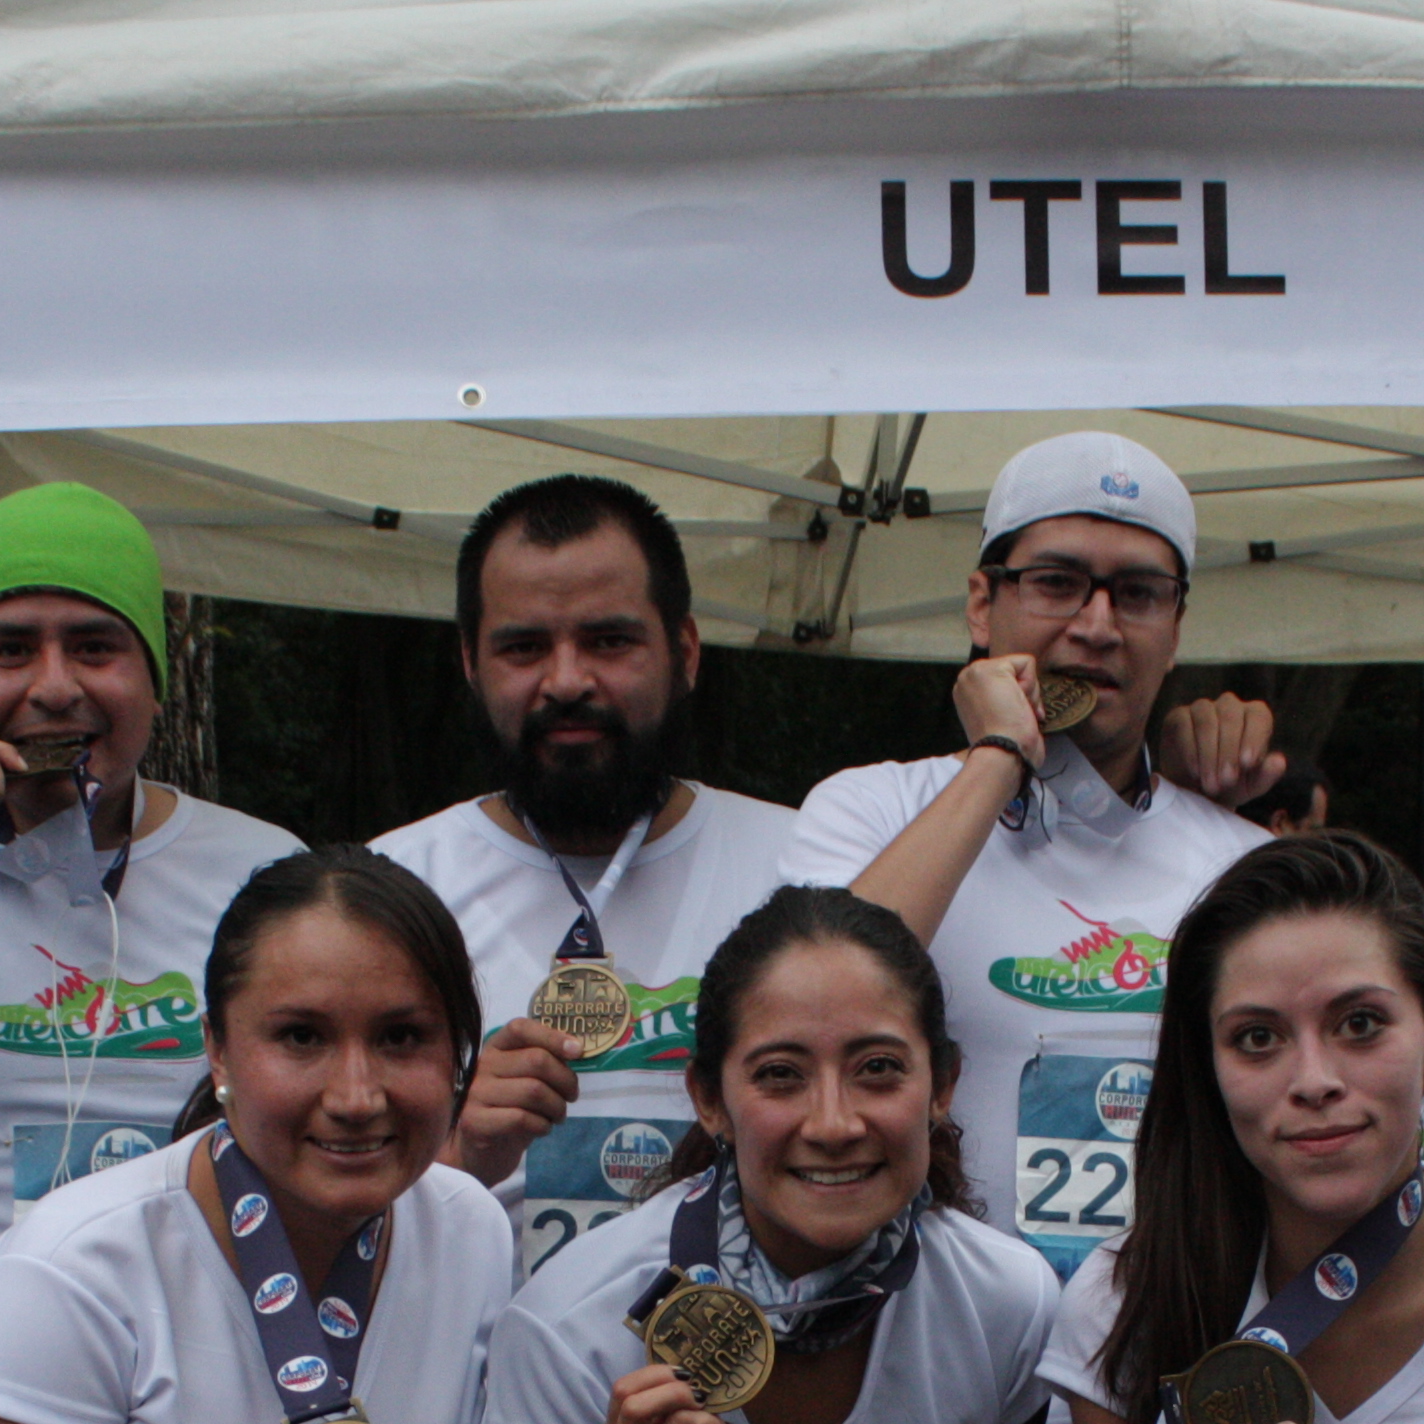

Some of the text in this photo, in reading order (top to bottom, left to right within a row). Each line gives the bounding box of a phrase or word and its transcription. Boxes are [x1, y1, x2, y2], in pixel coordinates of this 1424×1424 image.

[881, 179, 1286, 298] UTEL
[533, 1000, 625, 1017] CORPORATE
[1026, 1148, 1128, 1226] 22
[683, 1301, 751, 1374] RPORATE
